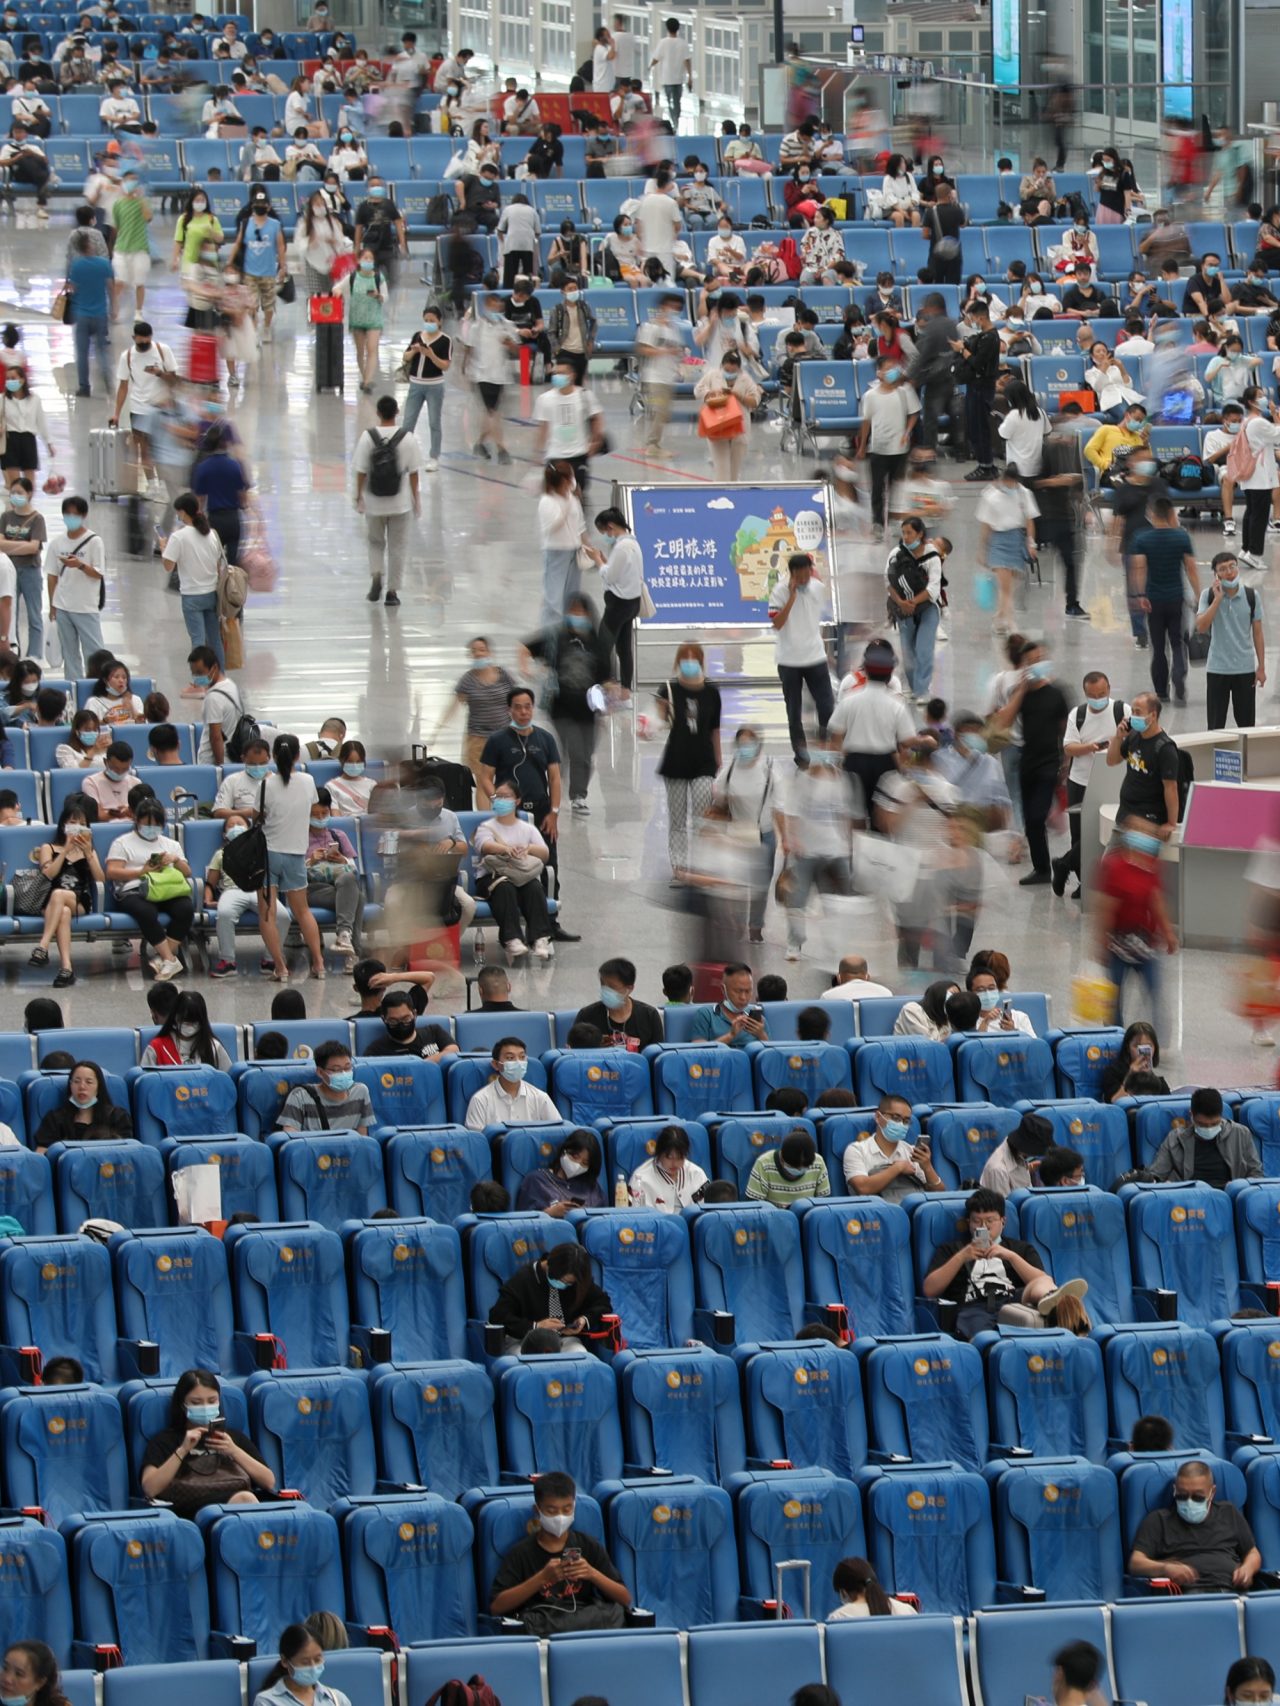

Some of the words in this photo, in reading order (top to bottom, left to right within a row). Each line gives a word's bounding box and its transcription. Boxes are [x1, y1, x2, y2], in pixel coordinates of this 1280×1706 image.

[653, 537, 718, 559] 文明旅游
[659, 564, 715, 576] 文明是最美的风景
